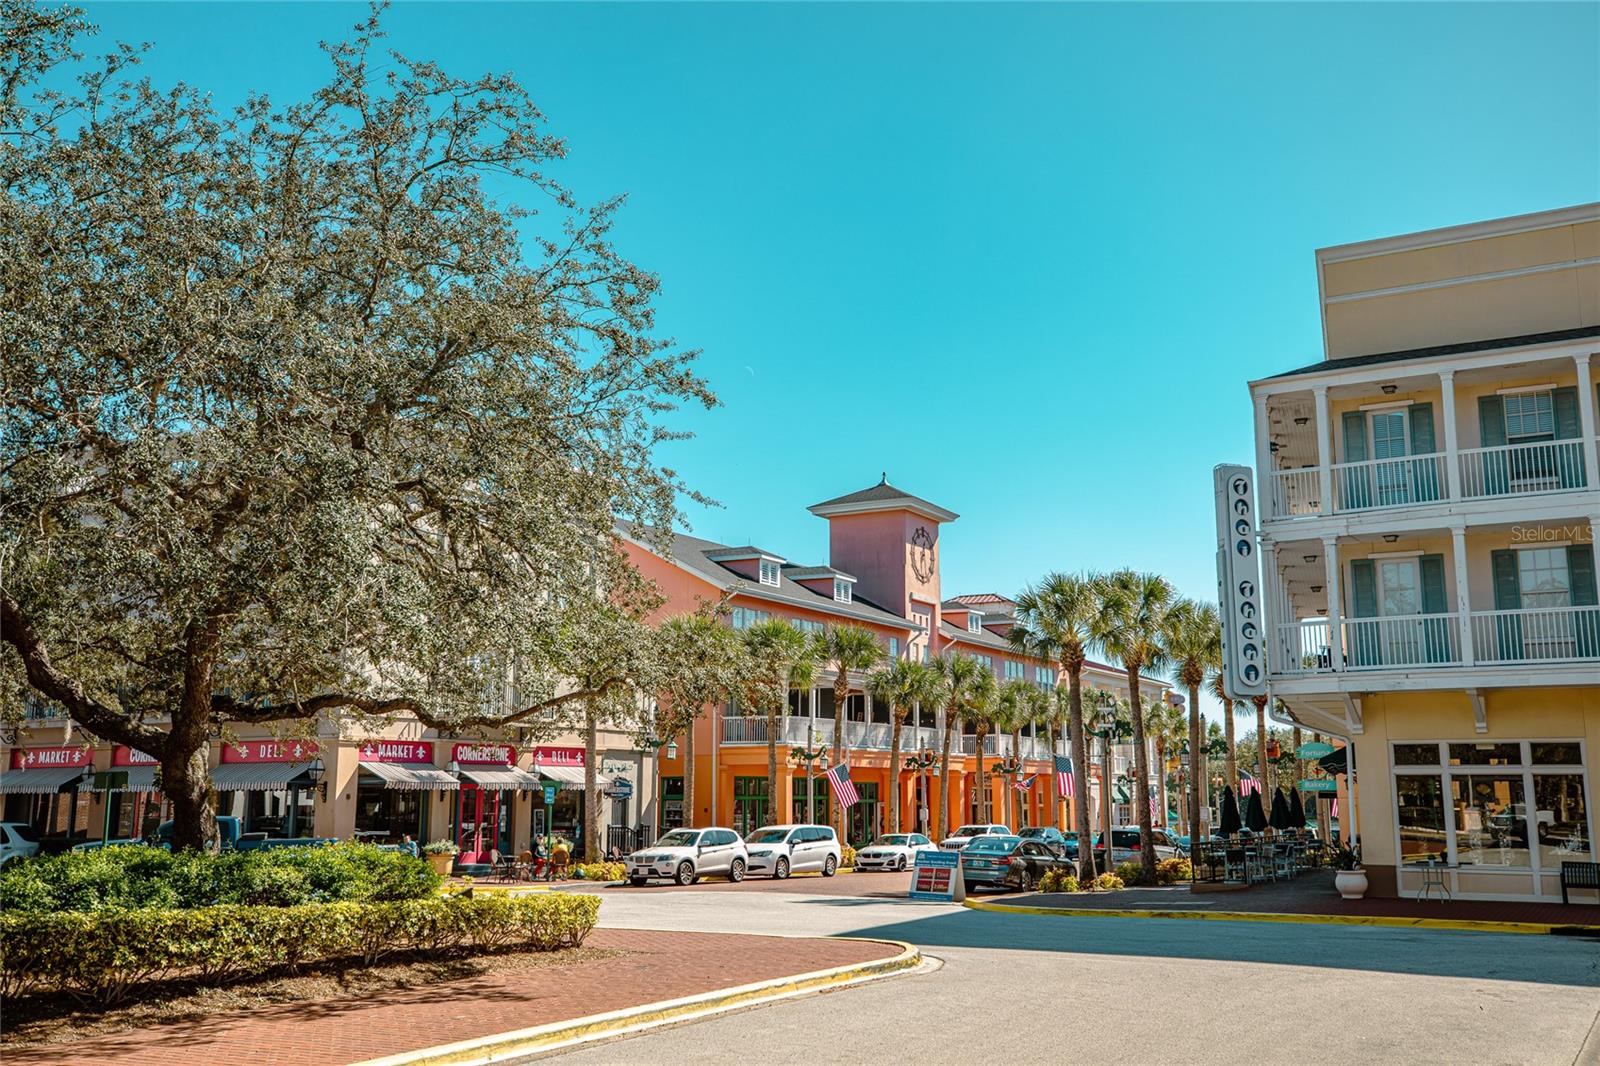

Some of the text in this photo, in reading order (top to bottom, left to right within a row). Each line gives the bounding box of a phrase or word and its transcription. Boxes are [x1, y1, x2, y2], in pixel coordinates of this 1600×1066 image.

[38, 750, 71, 764] MARKET
[378, 744, 414, 759] MARKET
[457, 745, 510, 762] CORNERSTONE
[551, 750, 570, 763] DELI
[1305, 781, 1330, 789] Bakery
